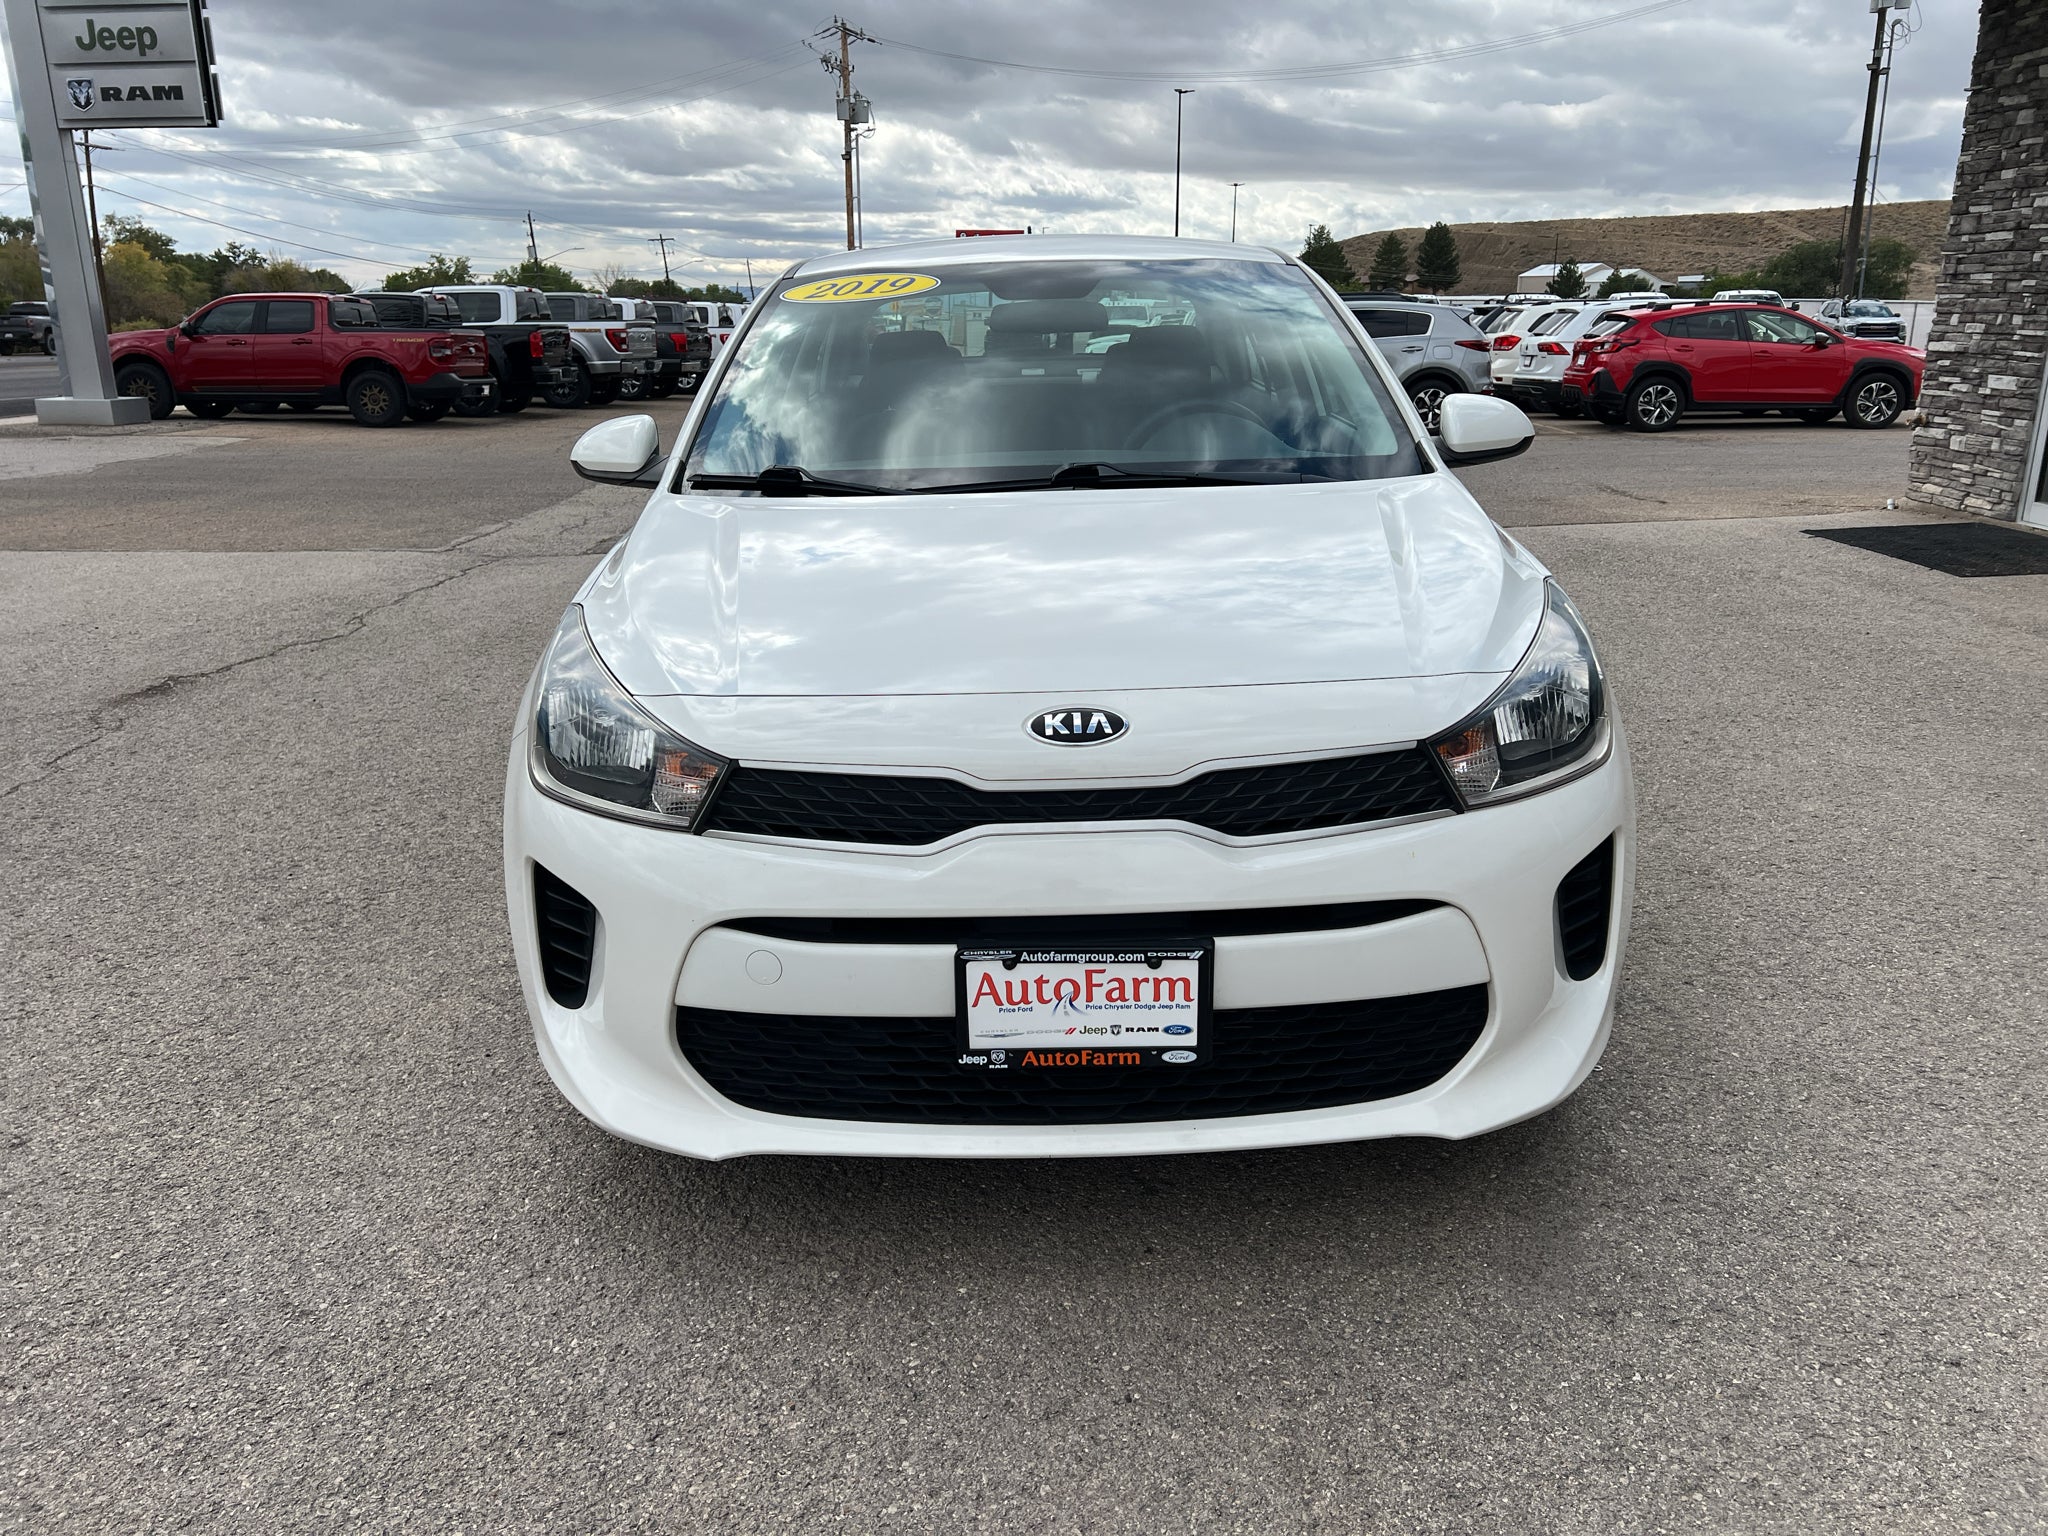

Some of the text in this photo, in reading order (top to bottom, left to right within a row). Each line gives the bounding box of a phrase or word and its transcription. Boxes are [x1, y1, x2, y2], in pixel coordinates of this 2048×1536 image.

[75, 18, 158, 57] Jeep
[100, 85, 184, 102] RAM
[804, 277, 917, 299] 2019
[1043, 712, 1113, 736] KIA
[1020, 951, 1145, 964] Autofarmgroup.com
[971, 967, 1195, 1008] AutoFarm
[1104, 1003, 1132, 1011] Chrysler
[1134, 1003, 1156, 1011] Dodge
[1079, 1025, 1108, 1036] Jeep
[958, 1054, 988, 1066] Jeep
[1021, 1050, 1141, 1067] AutoFarm
